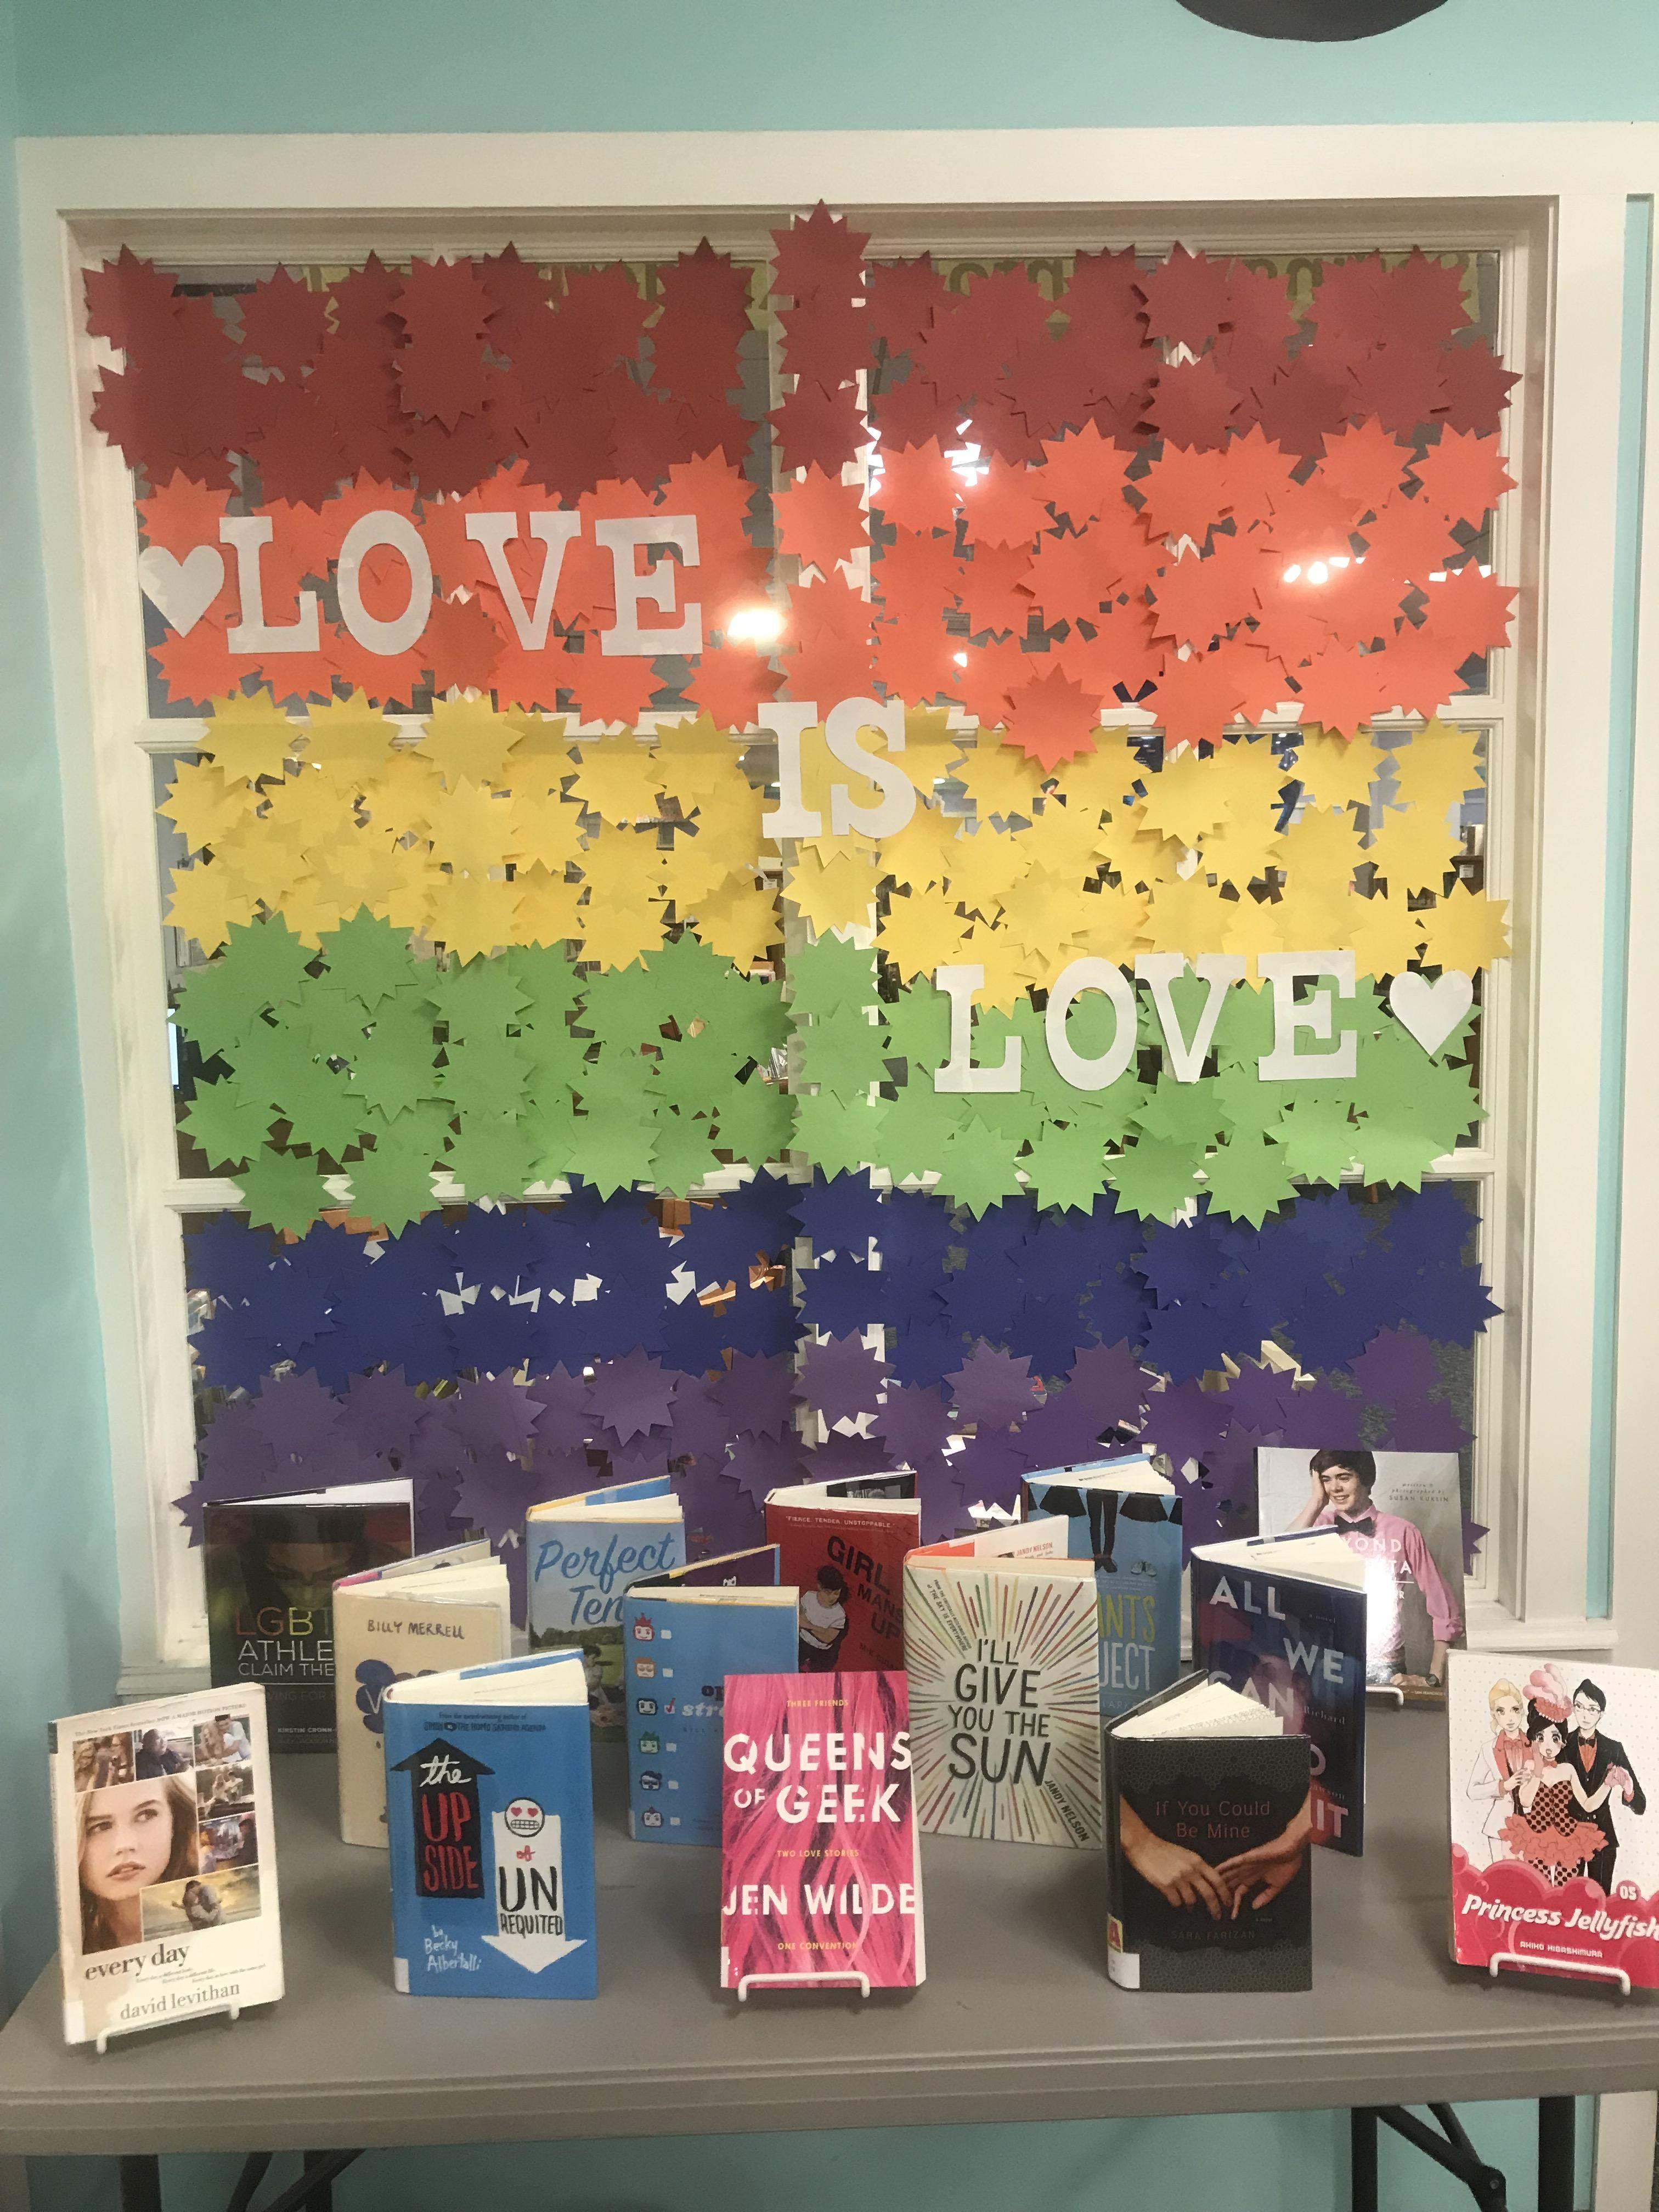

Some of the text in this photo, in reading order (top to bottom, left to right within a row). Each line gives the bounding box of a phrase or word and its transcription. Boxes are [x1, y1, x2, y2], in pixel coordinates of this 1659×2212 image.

[219, 510, 703, 656] LOVE
[758, 697, 916, 838] IS
[934, 950, 1357, 1092] LOVE
[534, 1532, 675, 1594] Perfect
[827, 1536, 890, 1595] GIRL
[569, 1584, 623, 1626] Ten
[857, 1583, 904, 1624] MANS
[930, 1589, 940, 1600] THE
[936, 1601, 946, 1612] SKY
[1209, 1576, 1285, 1620] ALL
[367, 1620, 465, 1640] BILLY MERRELL
[871, 1611, 902, 1639] UP
[238, 1640, 334, 1661] ATHLE
[979, 1638, 1019, 1666] I'LL
[1283, 1637, 1344, 1684] WE
[238, 1663, 334, 1676] CLAIM THE
[955, 1663, 1041, 1707] GIVE
[949, 1704, 1051, 1737] YOU THE
[1304, 1705, 1346, 1725] Richard
[420, 1754, 472, 1788] the
[724, 1731, 912, 1775] QUEENS
[949, 1733, 1051, 1786] SUN
[421, 1791, 472, 1842] UP
[733, 1784, 901, 1824] OF GEEK
[1045, 1780, 1090, 1842] JANDY NELSON
[1155, 1801, 1271, 1816] If You Could
[1317, 1799, 1349, 1838] IT
[1176, 1822, 1251, 1838] Be Mine
[424, 1845, 479, 1892] SIDE
[824, 1849, 860, 1857] STORIES
[499, 1865, 558, 1913] UN
[721, 1883, 916, 1916] JEN WILDE
[1619, 1885, 1638, 1901] 05
[500, 1913, 563, 1939] REQUITED
[1461, 1893, 1659, 1942] Princess Jellyfish
[85, 1943, 190, 1980] every day
[424, 1937, 458, 1956] Becky
[427, 1953, 482, 1972] Albertalli
[777, 1942, 858, 1950] ONE CONVENTION
[1520, 1940, 1545, 1951] AKIKO
[120, 1983, 240, 2021] david levithan
